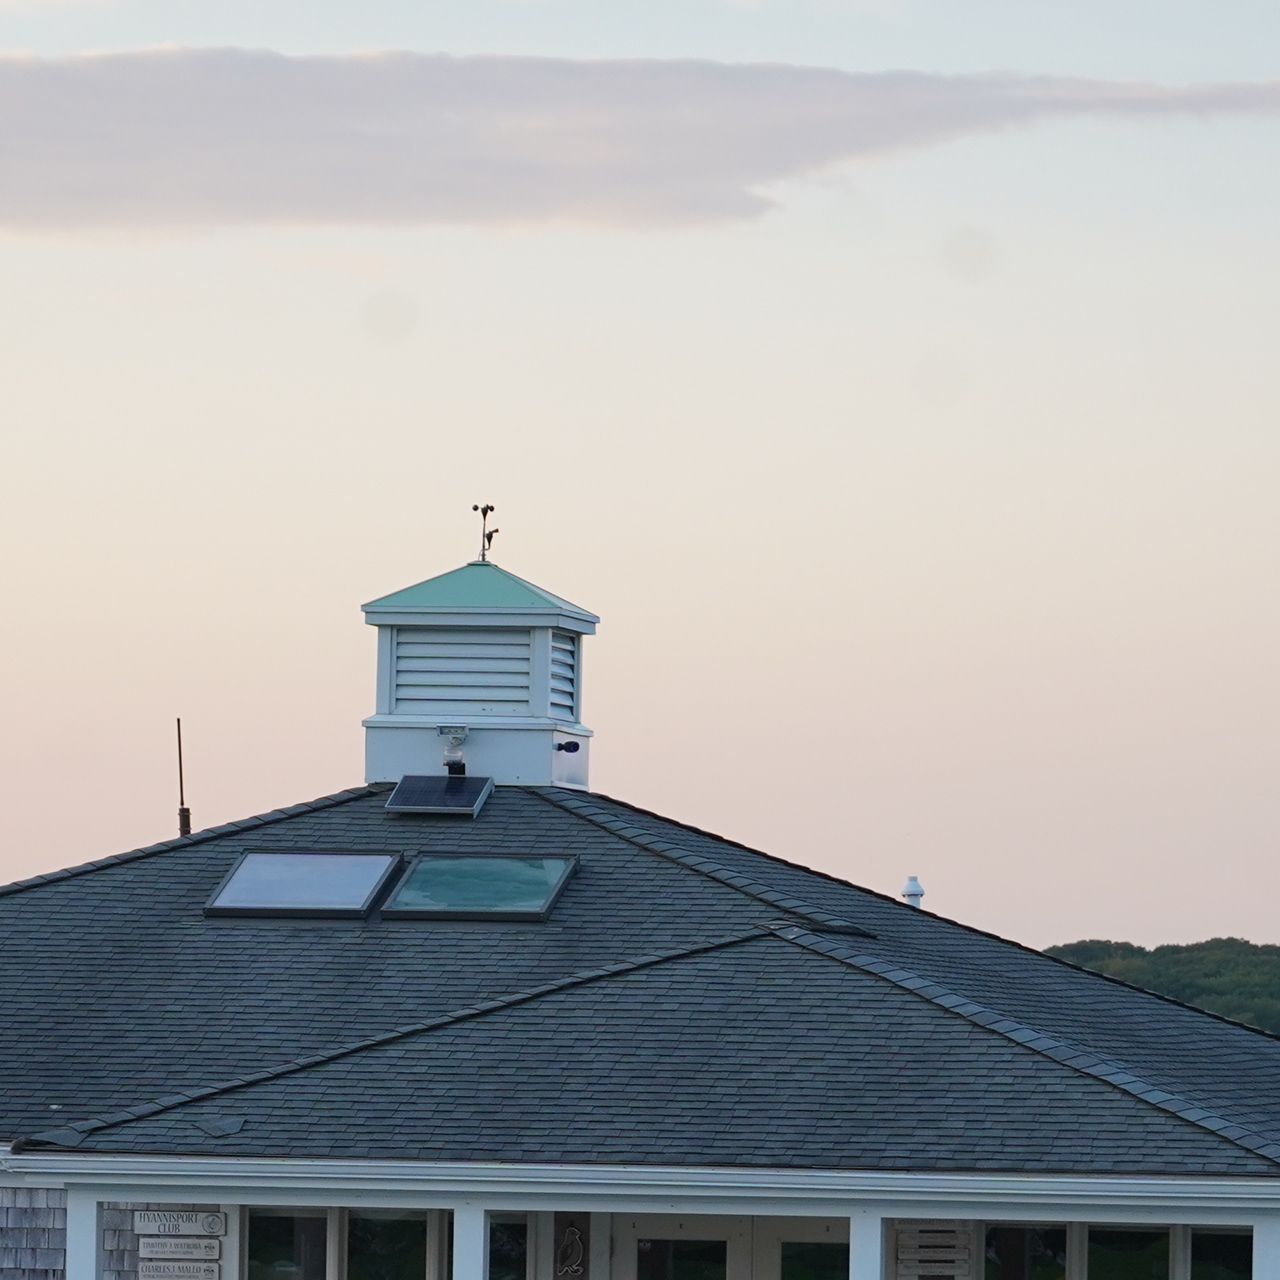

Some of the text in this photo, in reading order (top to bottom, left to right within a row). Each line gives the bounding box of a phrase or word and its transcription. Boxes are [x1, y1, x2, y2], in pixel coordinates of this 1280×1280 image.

[139, 1212, 199, 1223] HYANNISPORT
[157, 1223, 181, 1234] CLUB
[141, 1265, 170, 1273] CHARLES
[178, 1265, 201, 1273] MALLO
